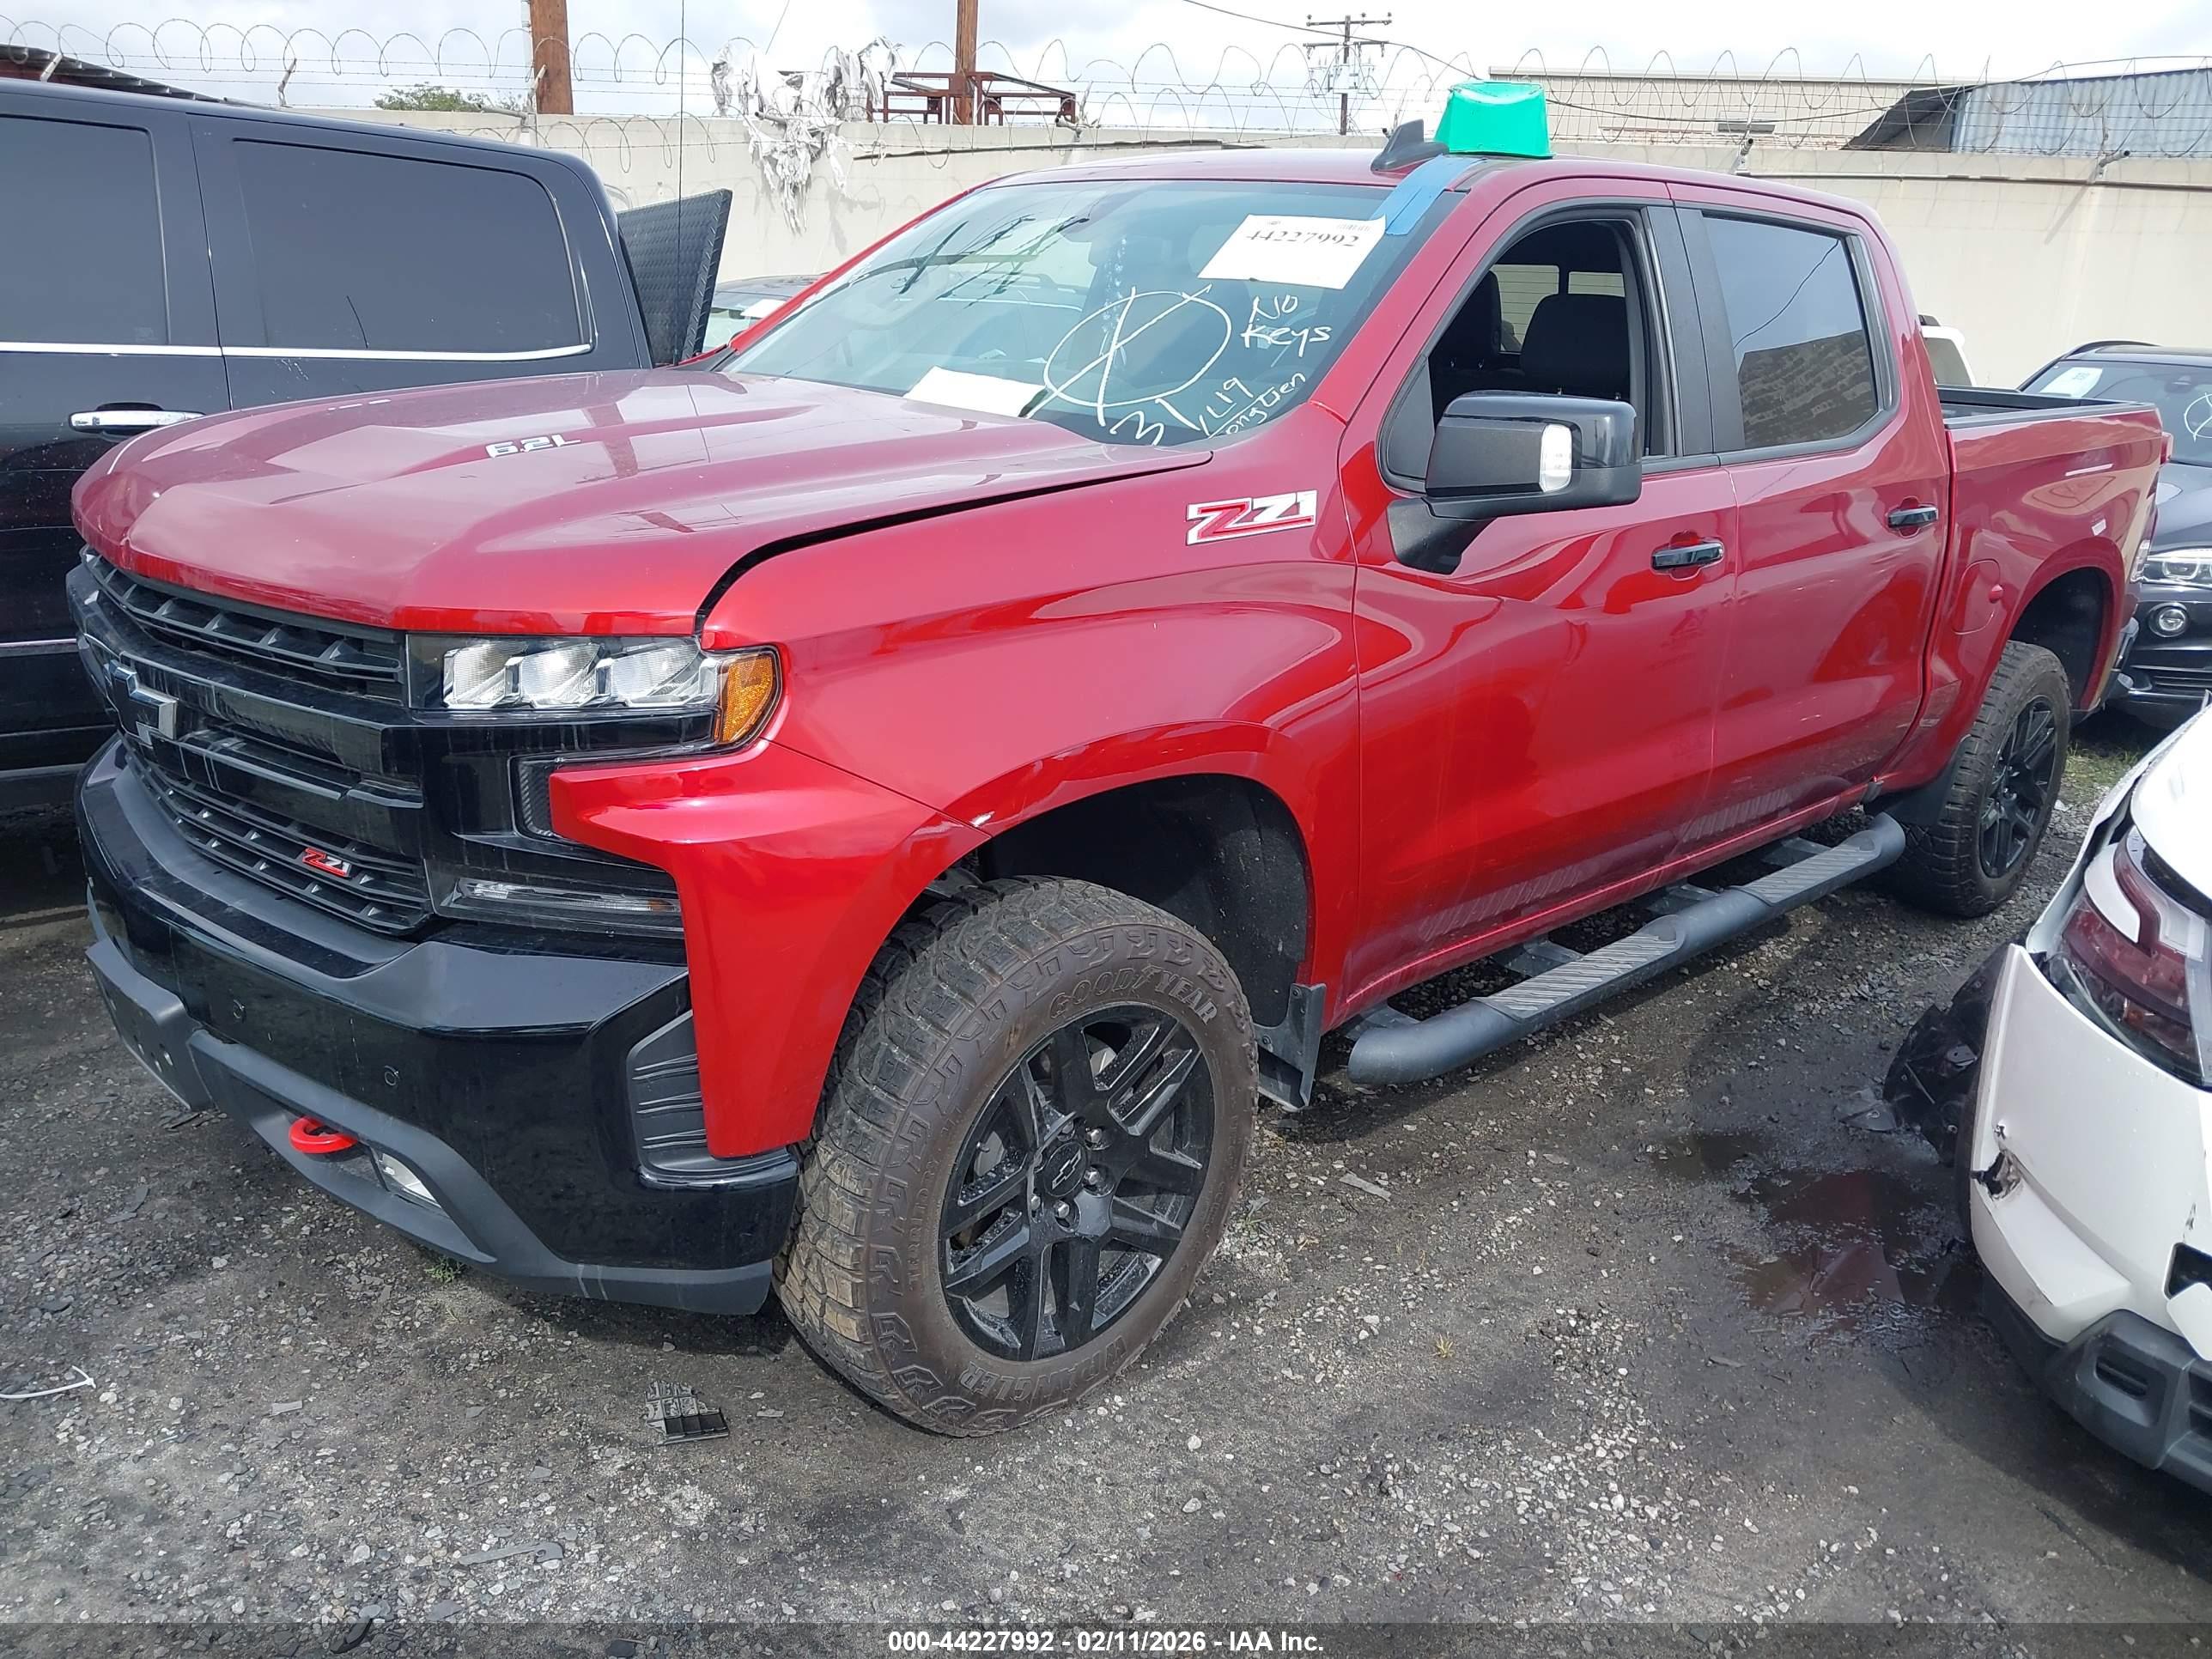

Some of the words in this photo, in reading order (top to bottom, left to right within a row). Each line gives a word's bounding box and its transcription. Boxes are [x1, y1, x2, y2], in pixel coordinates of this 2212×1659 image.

[1246, 229, 1360, 247] 44227992
[1186, 489, 1318, 546] Z71
[1048, 966, 1218, 1025] GOODYEAR
